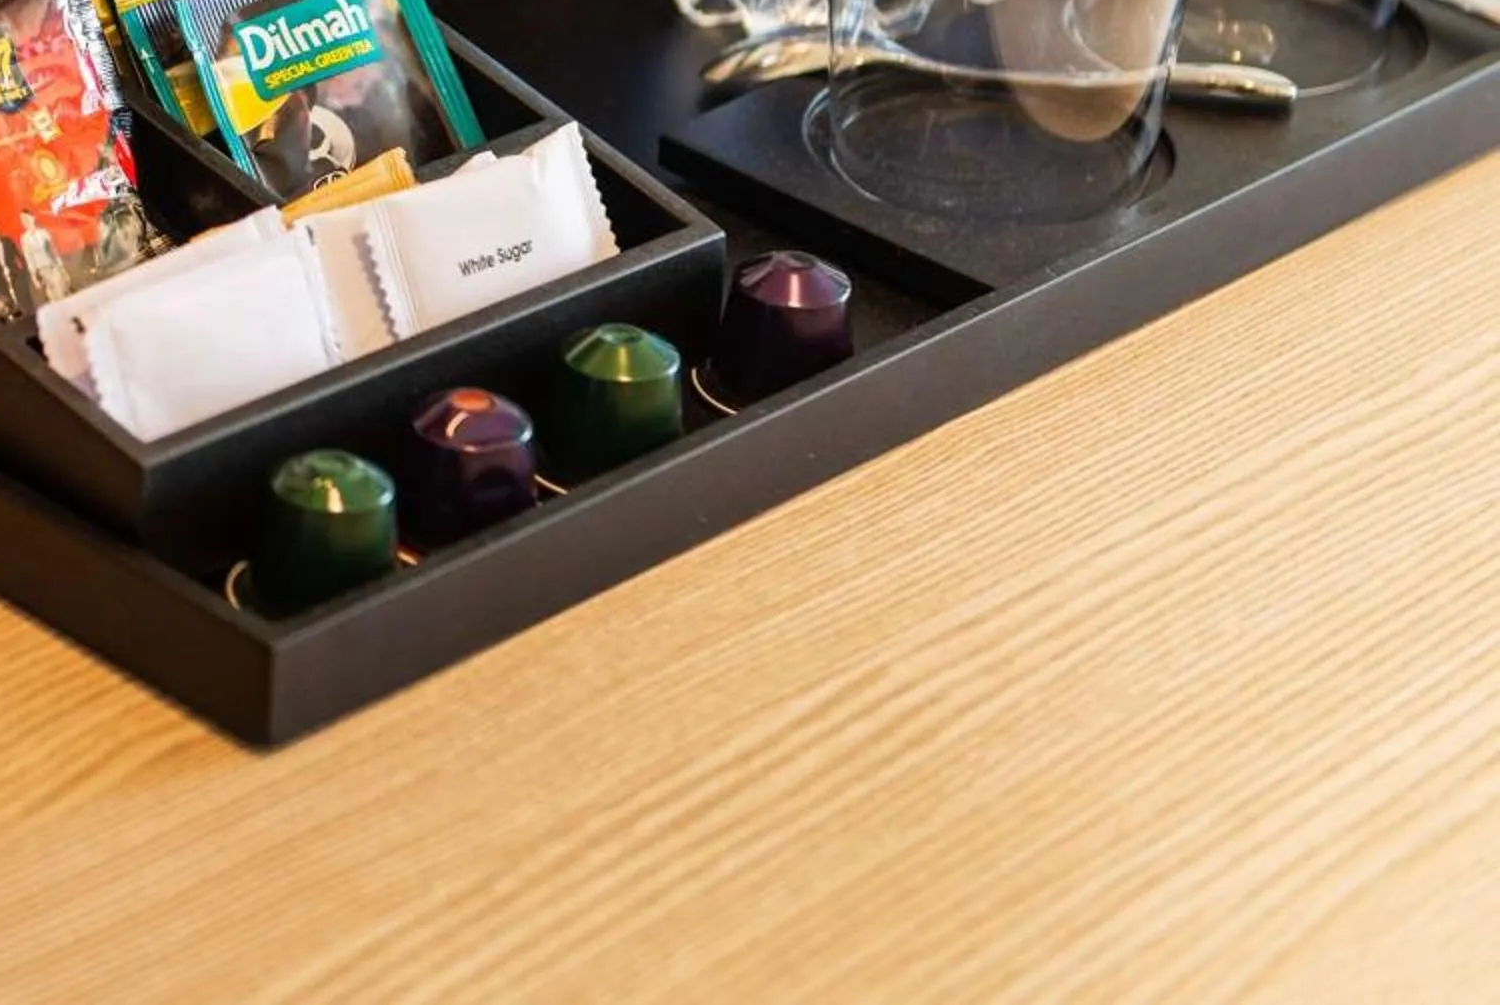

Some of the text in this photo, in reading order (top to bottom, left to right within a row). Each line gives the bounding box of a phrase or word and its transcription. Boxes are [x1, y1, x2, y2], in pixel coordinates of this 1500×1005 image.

[263, 58, 314, 90] SPECIAL
[315, 45, 354, 69] GREEN
[458, 239, 533, 276] White Sugar
